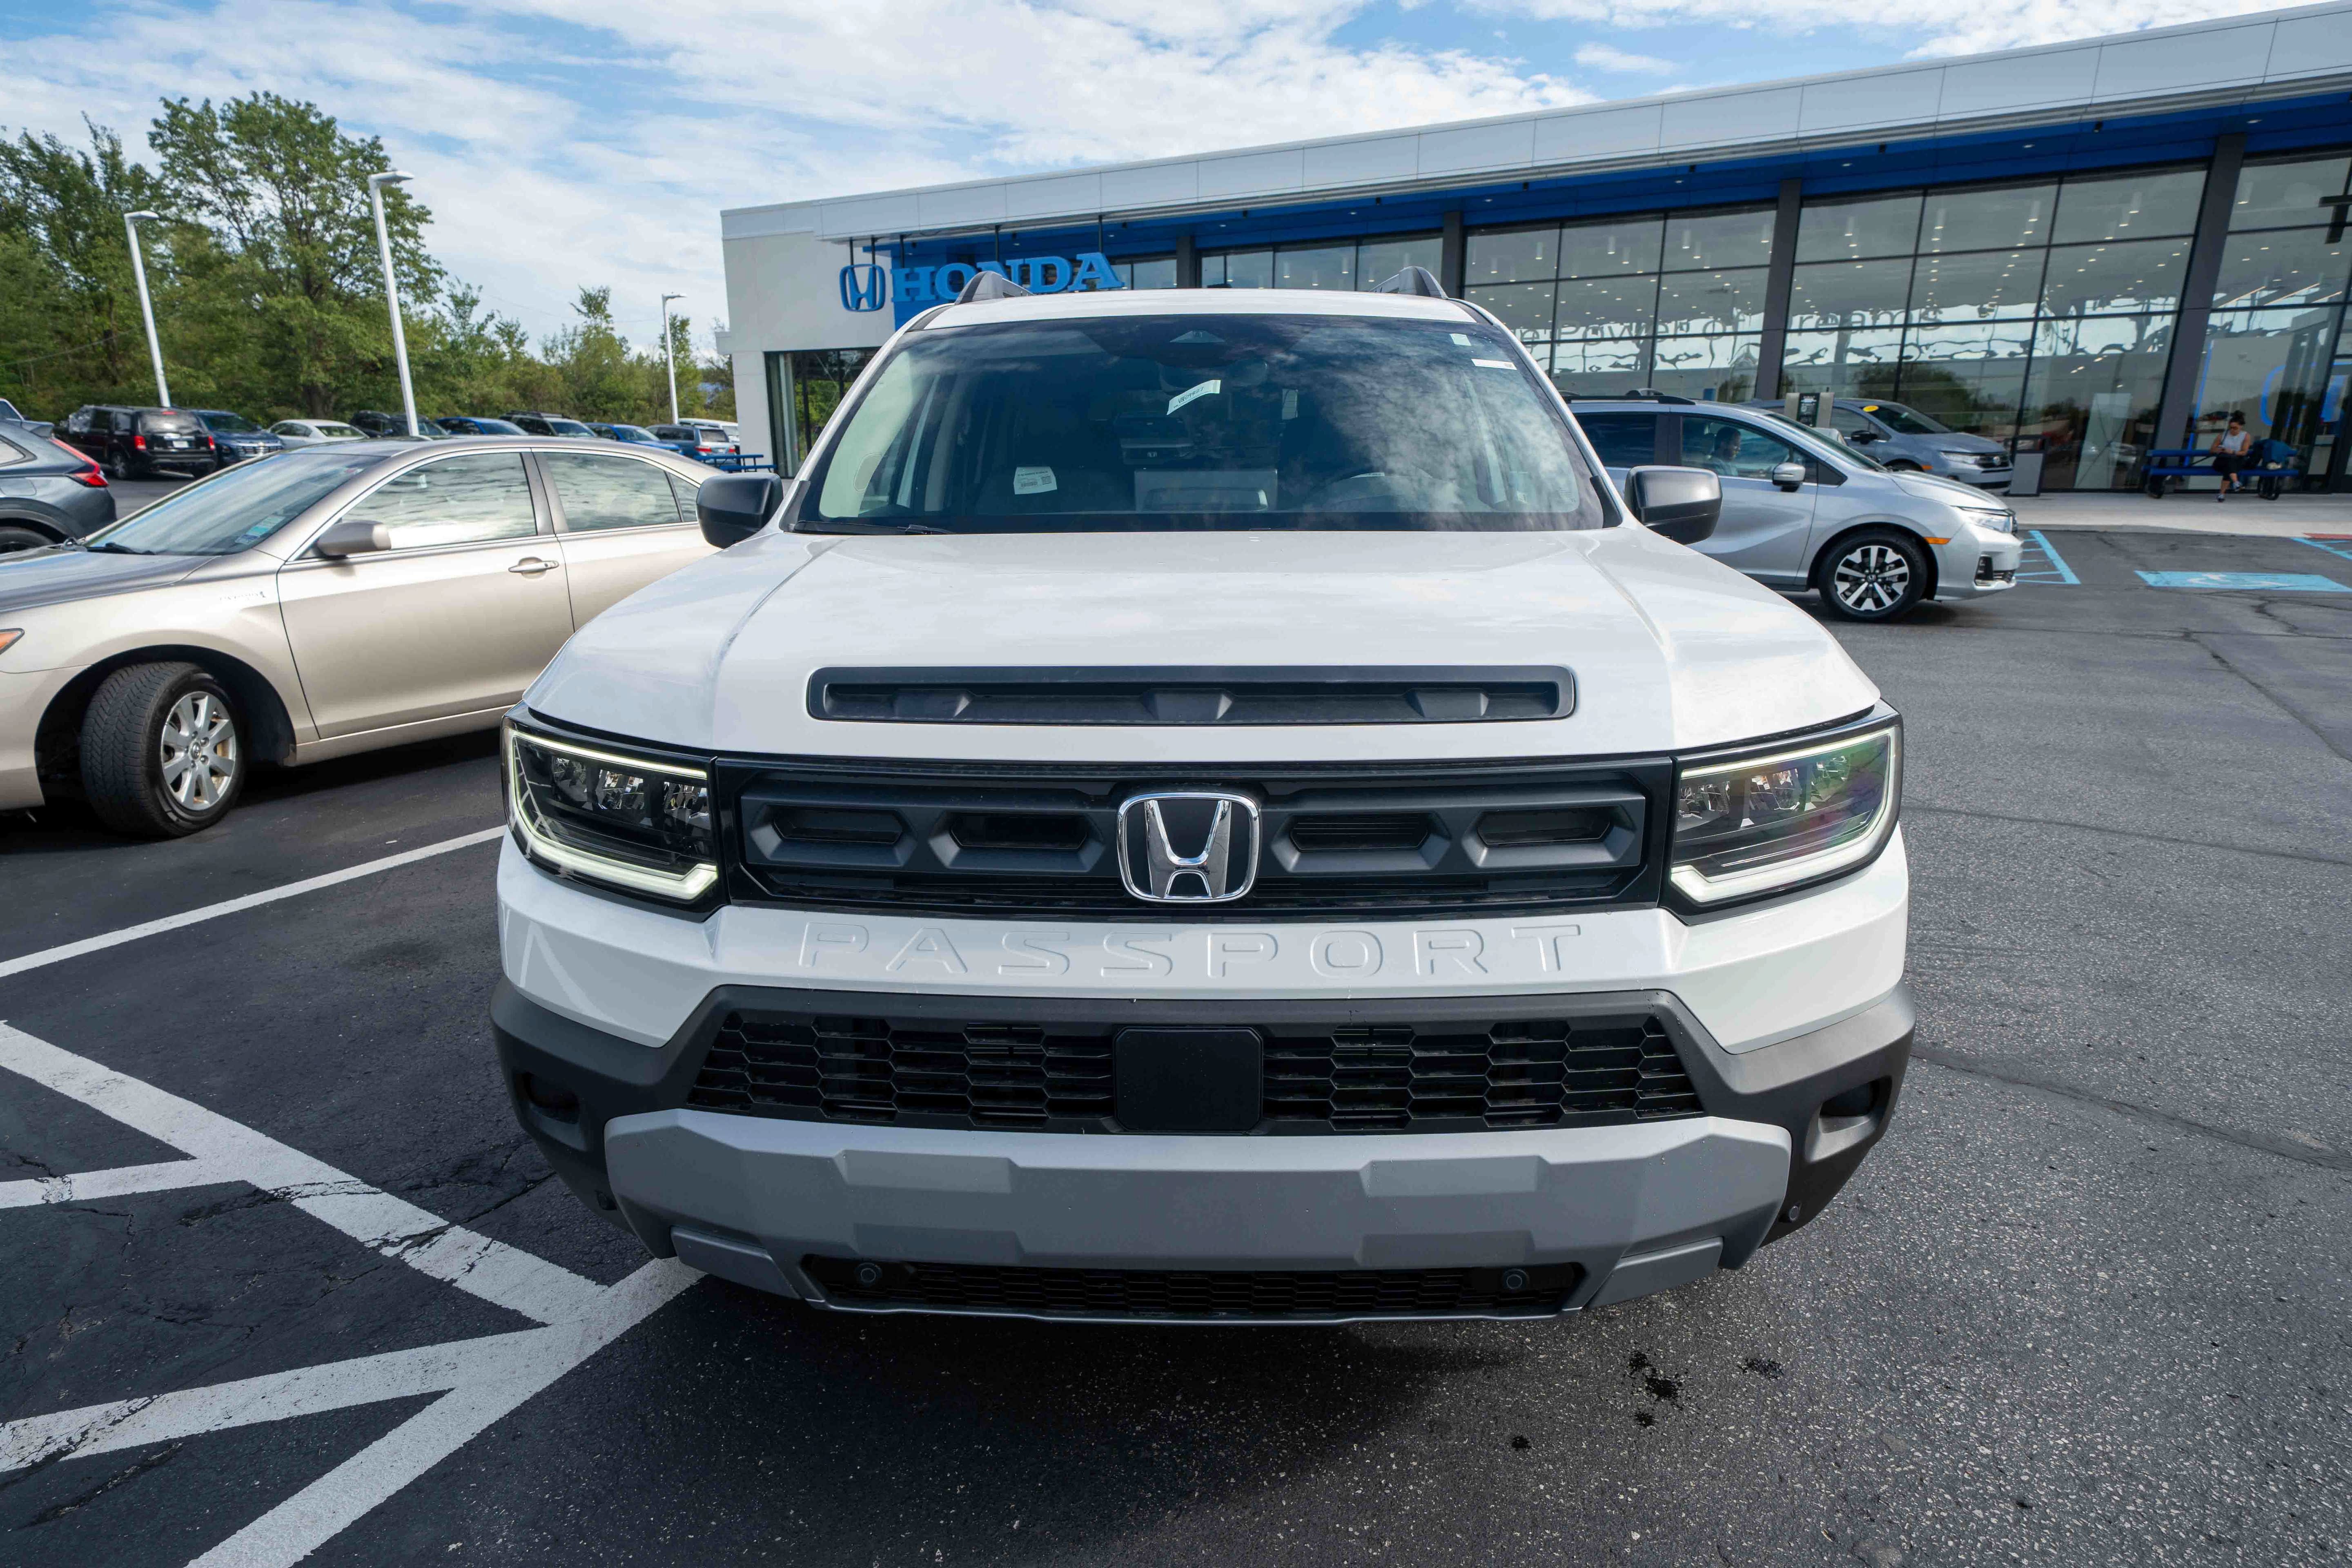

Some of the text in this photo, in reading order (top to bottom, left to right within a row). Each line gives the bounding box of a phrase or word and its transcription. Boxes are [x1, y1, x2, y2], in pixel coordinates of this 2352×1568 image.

[891, 252, 1125, 302] HONDA
[1790, 305, 1944, 336] reams
[798, 921, 1581, 978] PASSPORT
